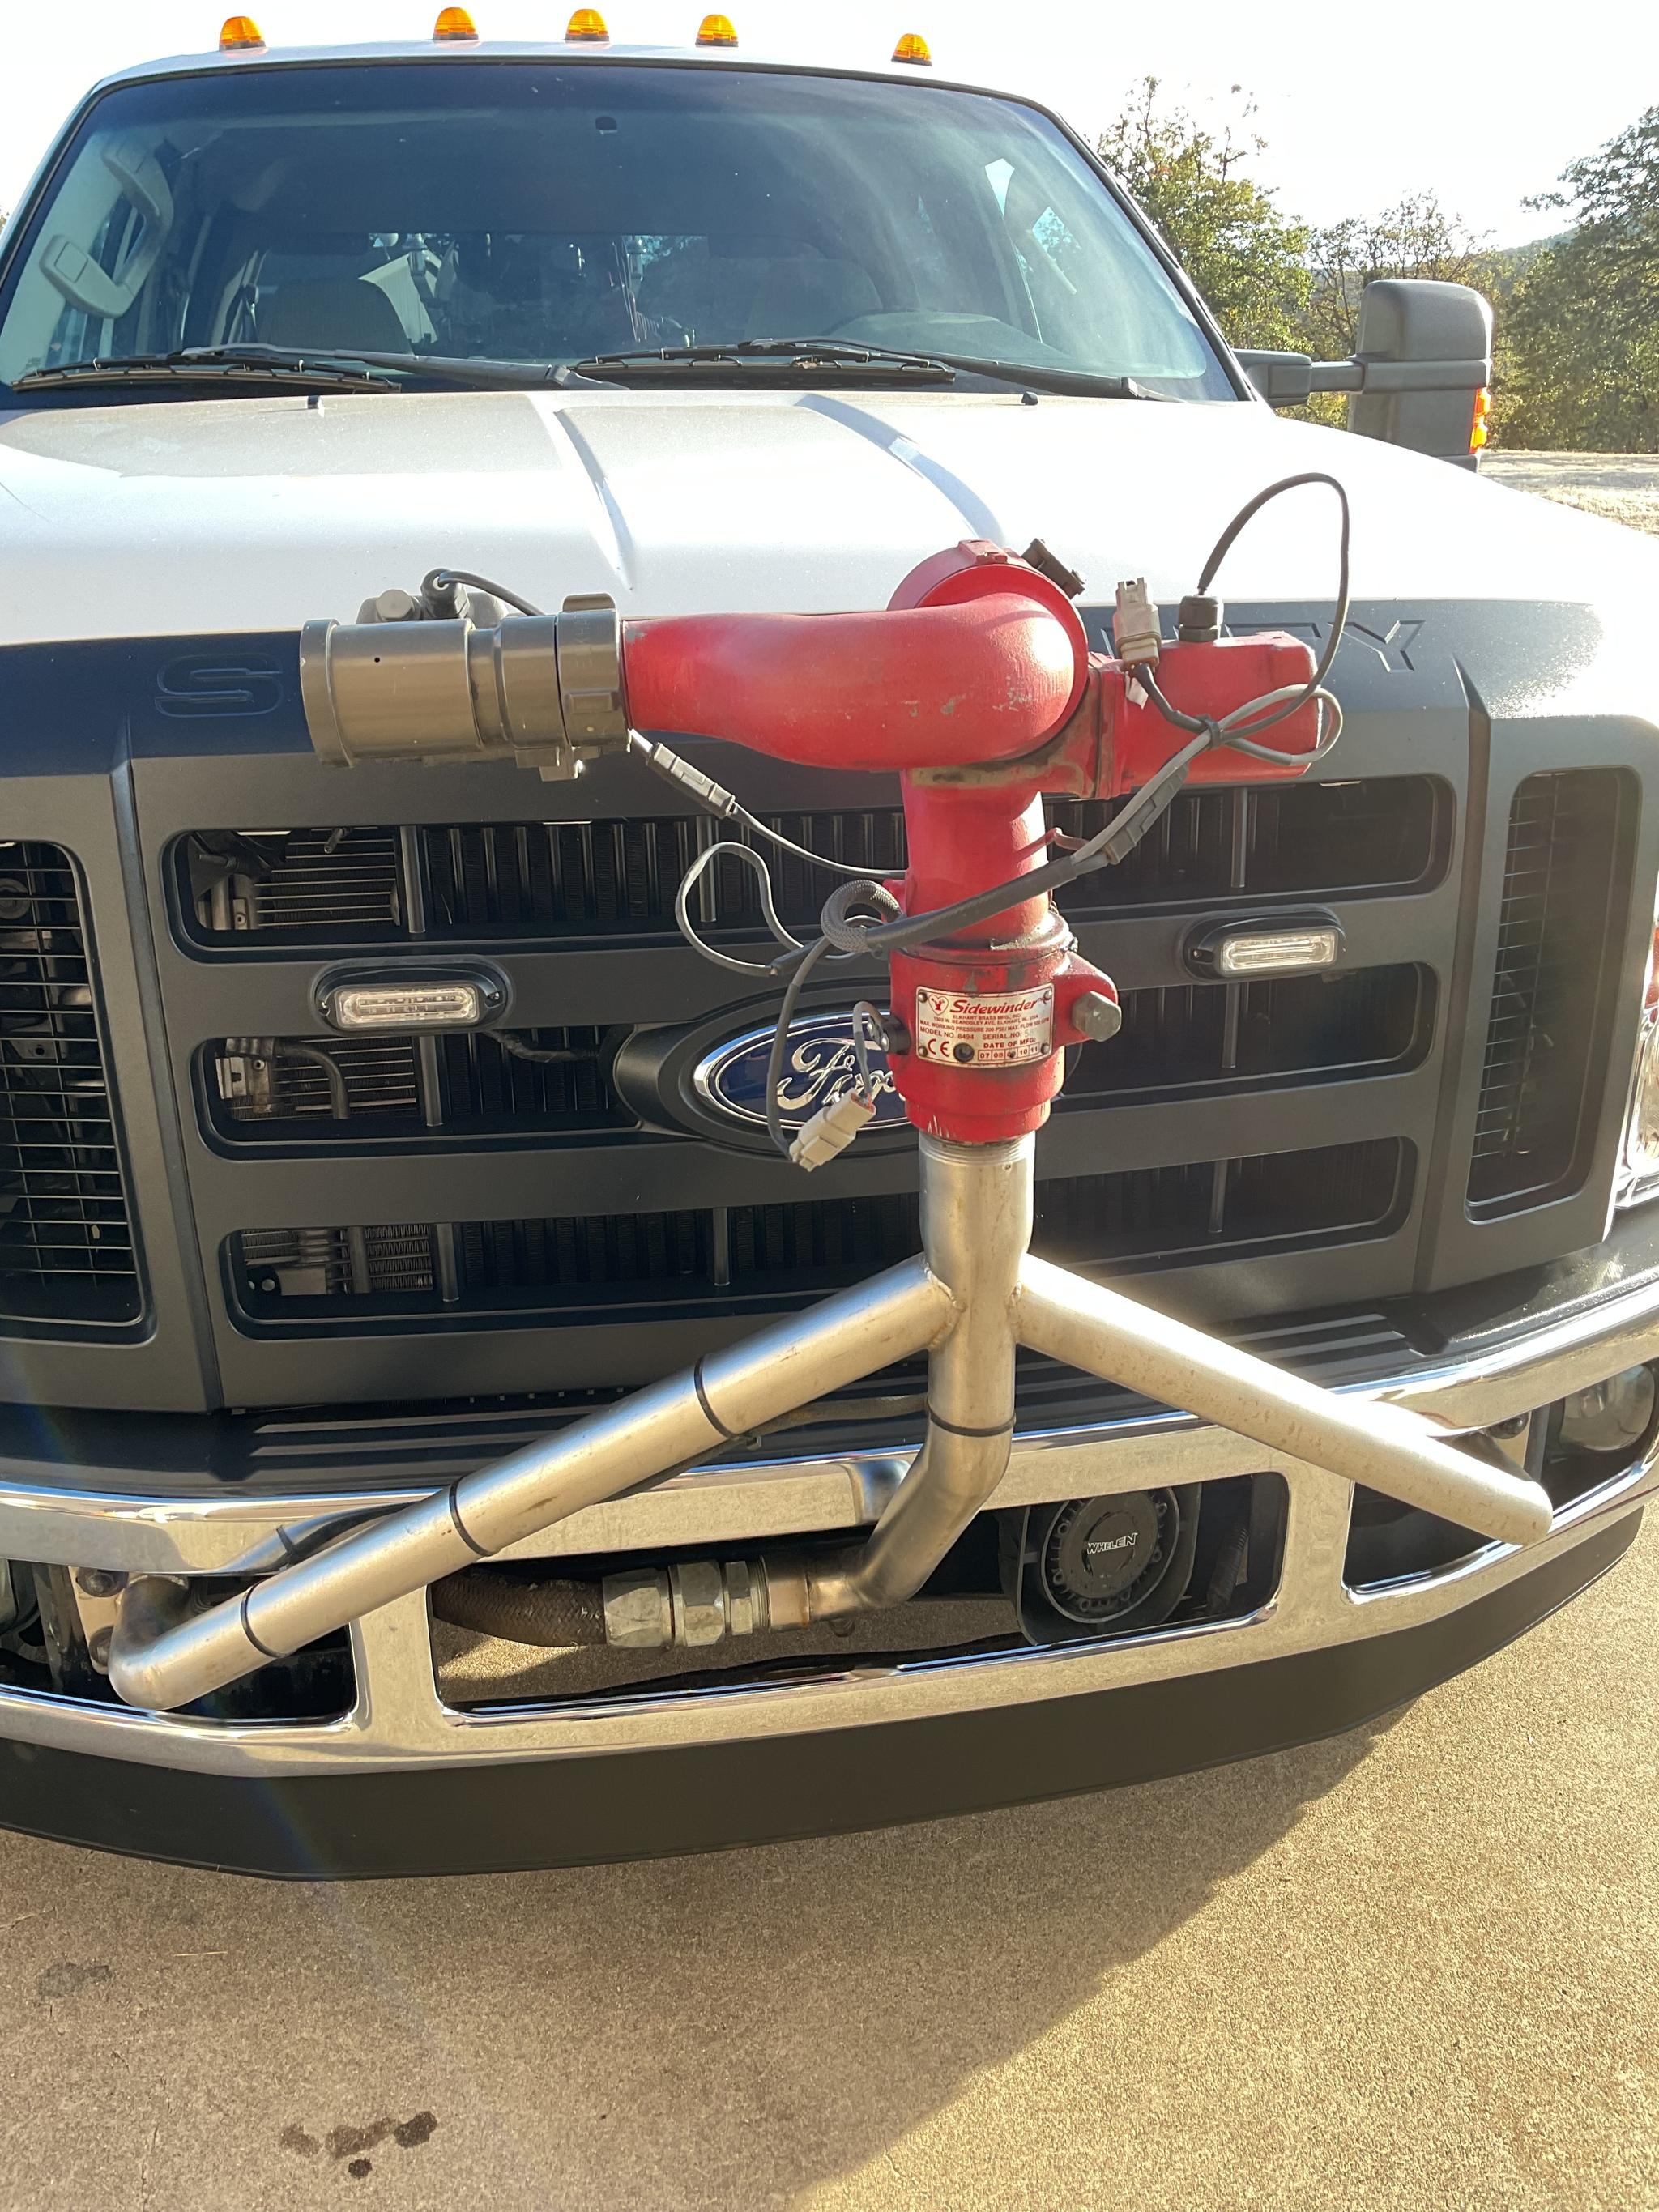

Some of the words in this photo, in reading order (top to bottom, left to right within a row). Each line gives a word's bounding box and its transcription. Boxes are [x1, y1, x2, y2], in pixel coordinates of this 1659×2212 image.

[949, 999, 1038, 1014] Sidewinder
[920, 1026, 942, 1037] MODEL
[932, 1022, 954, 1030] WORKING
[928, 1038, 949, 1057] CE
[1019, 1037, 1036, 1045] MFG:
[777, 1038, 906, 1110] For
[1086, 1532, 1138, 1555] WHELEN
